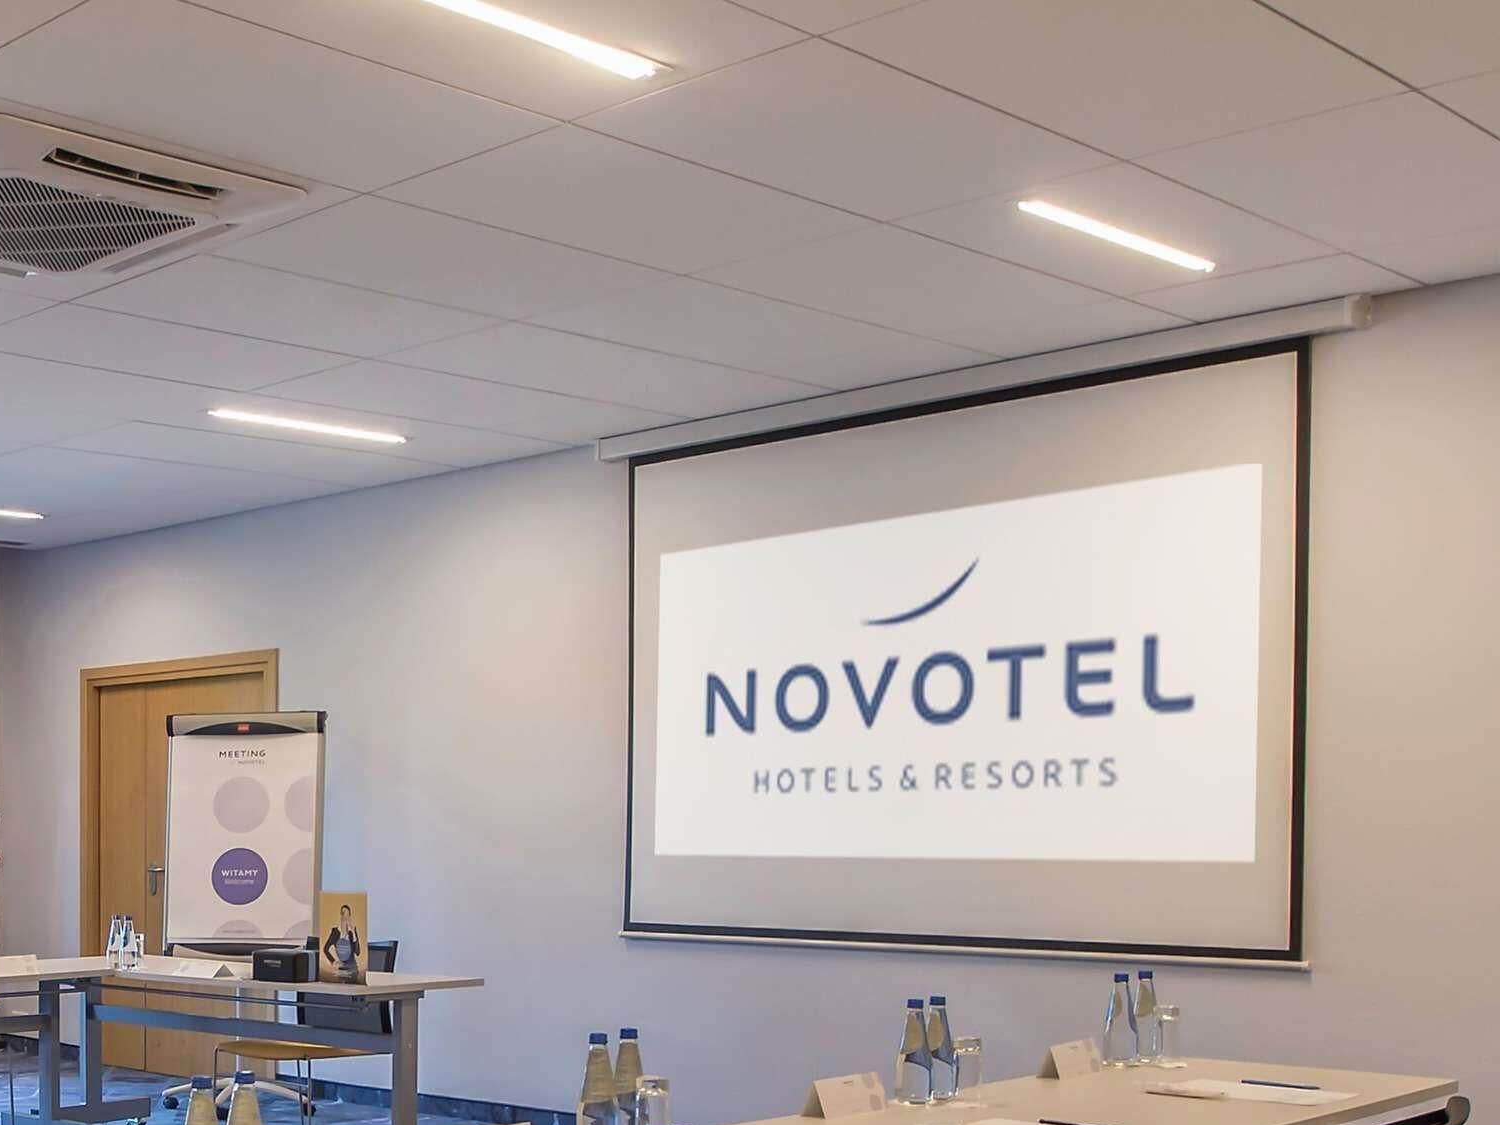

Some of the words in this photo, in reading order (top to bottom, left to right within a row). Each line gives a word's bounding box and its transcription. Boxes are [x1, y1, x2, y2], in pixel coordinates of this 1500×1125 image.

[705, 634, 1195, 738] NOVOTEL
[219, 749, 266, 759] MEETING
[753, 764, 884, 795] HOTELS
[899, 763, 919, 792] &
[934, 757, 1119, 792] RESORTS
[221, 869, 259, 877] WITAMY
